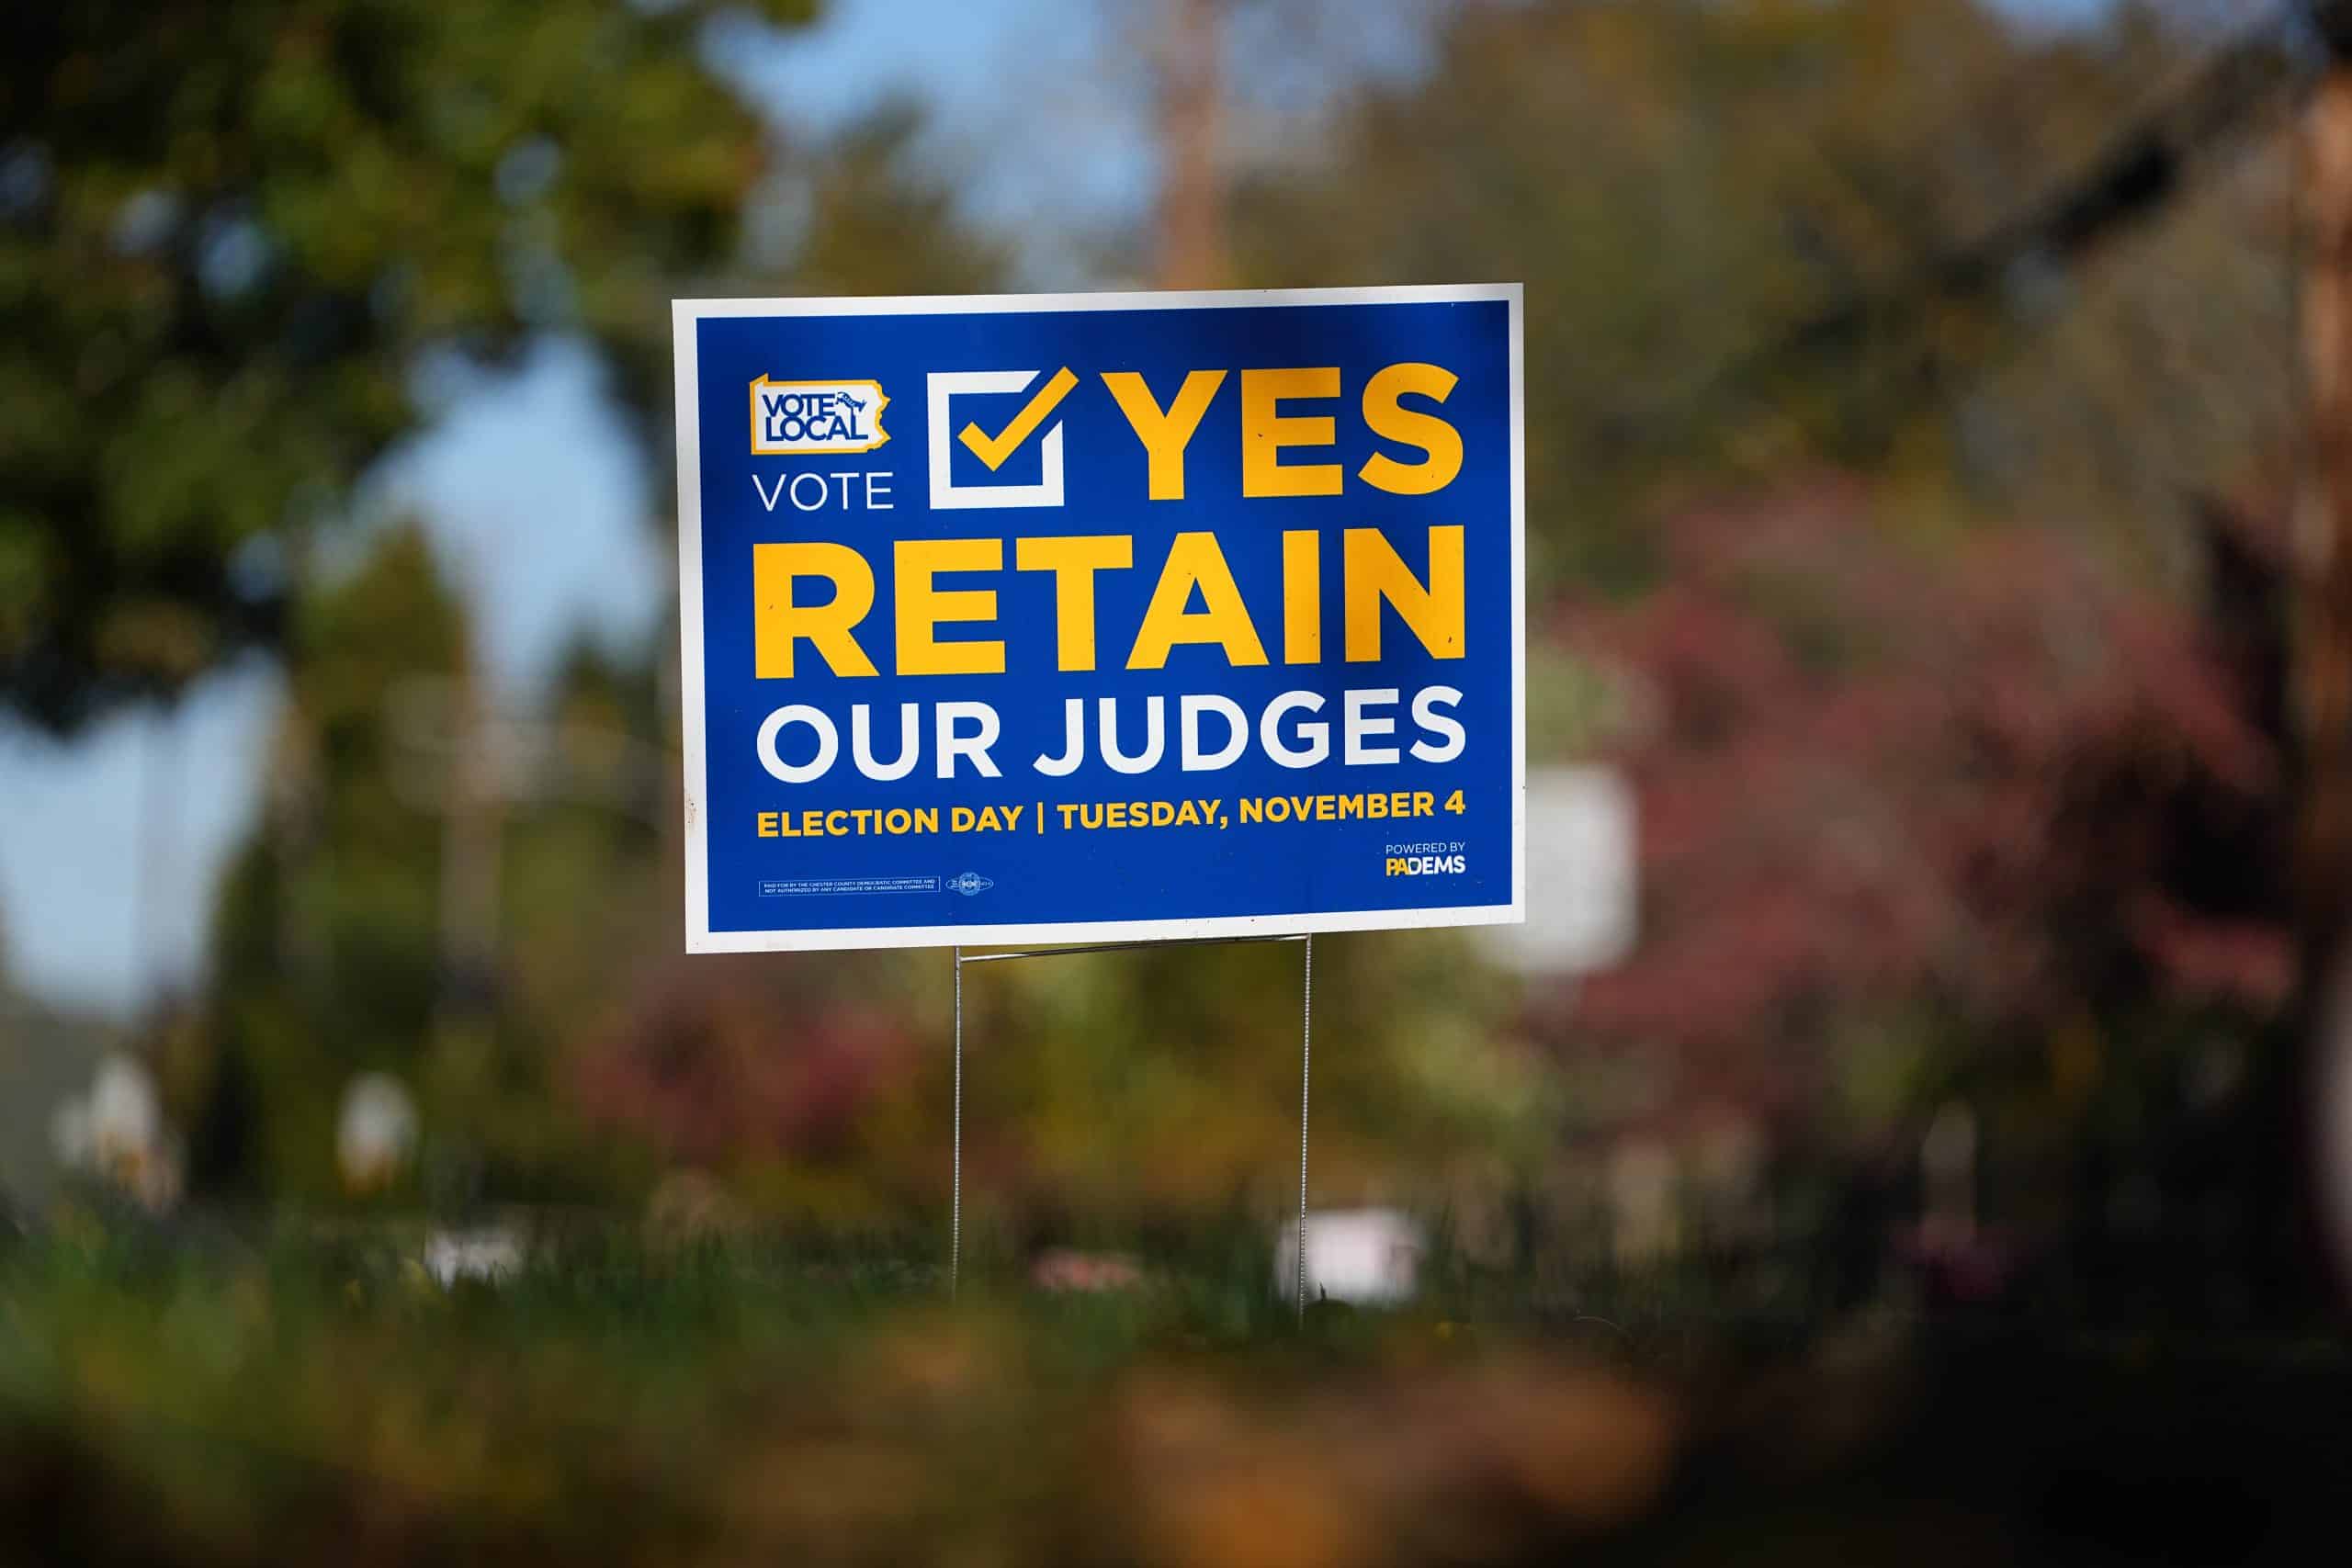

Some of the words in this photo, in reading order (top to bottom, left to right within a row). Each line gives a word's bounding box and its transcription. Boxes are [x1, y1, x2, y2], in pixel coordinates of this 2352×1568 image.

[762, 394, 836, 417] VOTE
[765, 415, 869, 441] LOCAL
[1100, 363, 1464, 501] YES
[752, 472, 894, 512] VOTE
[753, 525, 1465, 680] RETAIN
[756, 701, 1002, 783] OUR
[1033, 686, 1466, 777] JUDGES
[758, 808, 939, 838] ELECTION
[951, 806, 1024, 832] DAY
[1057, 800, 1228, 829] TUESDAY,
[1239, 792, 1434, 824] NOVEMBER
[1444, 790, 1466, 815] 4
[1385, 842, 1447, 854] POWERED
[1450, 842, 1465, 852] BY
[1385, 855, 1465, 876] PADEMS
